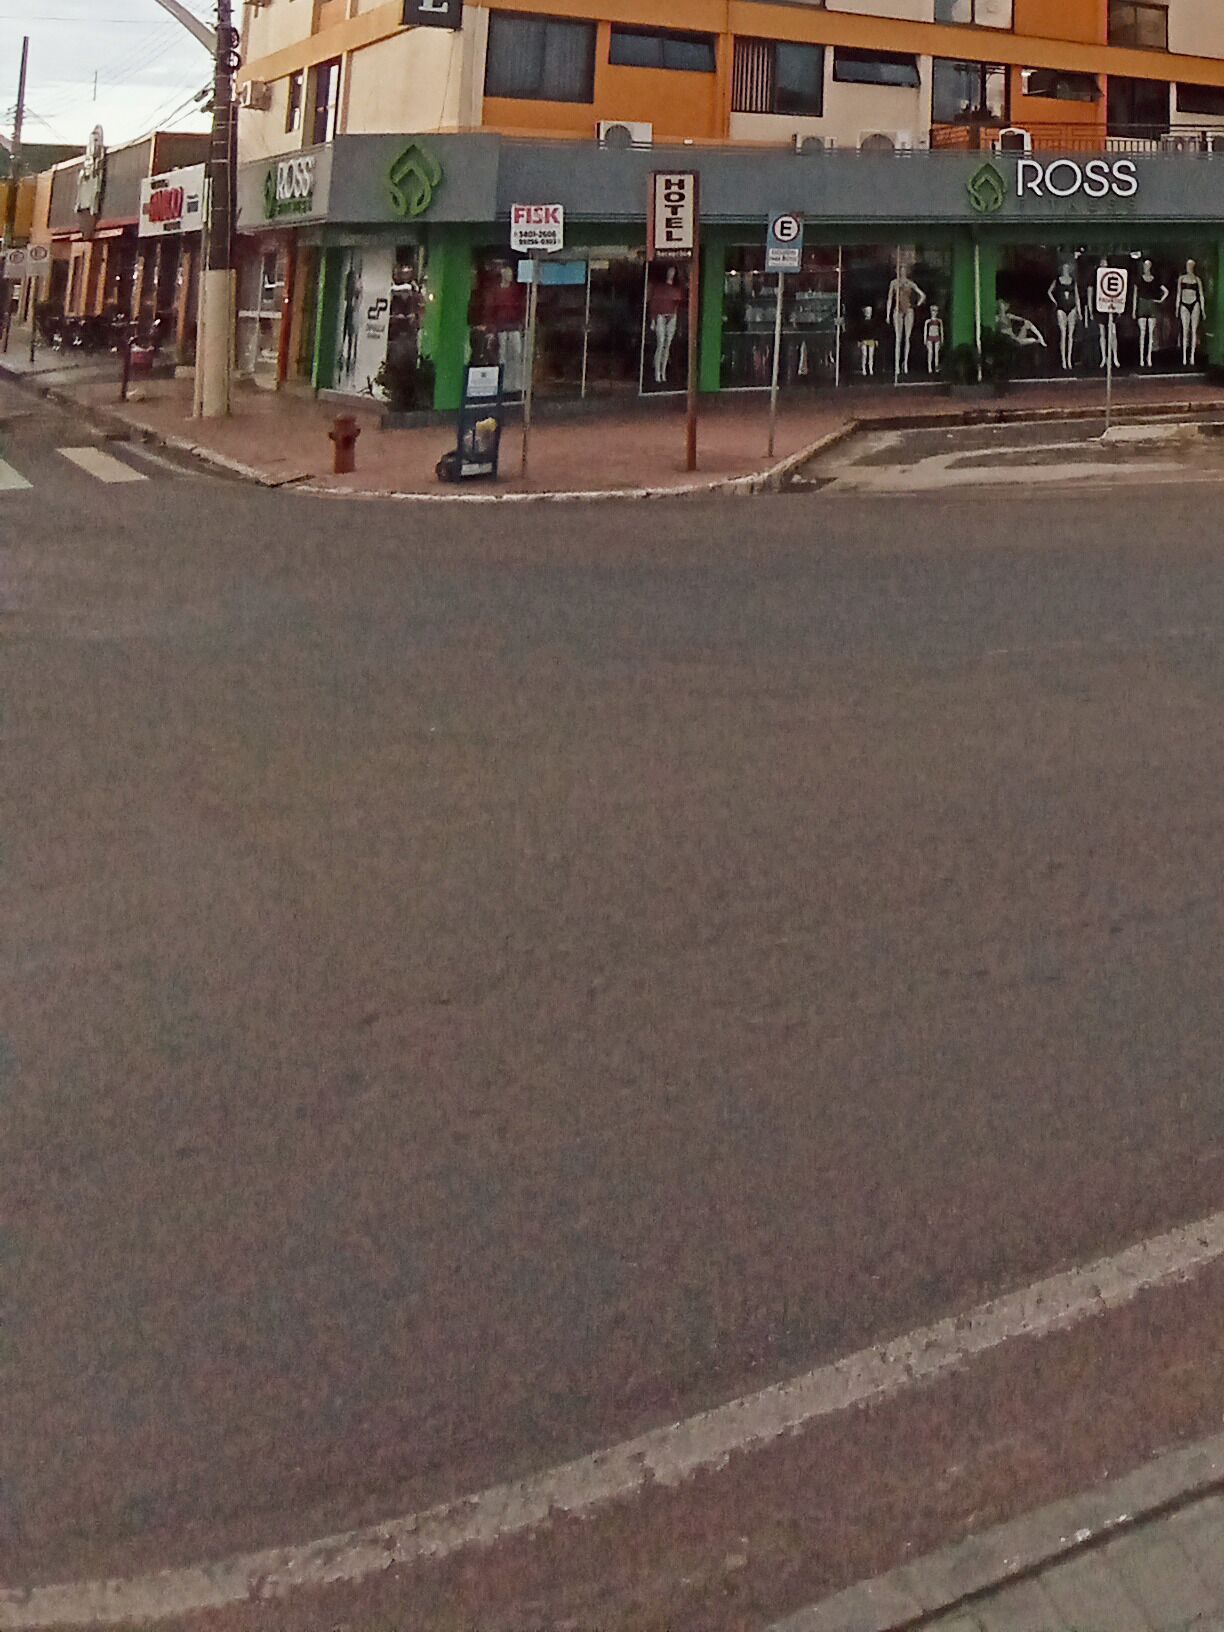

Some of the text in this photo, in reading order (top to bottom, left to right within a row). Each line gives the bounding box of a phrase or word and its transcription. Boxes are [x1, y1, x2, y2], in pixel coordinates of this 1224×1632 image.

[276, 156, 314, 200] ROSS
[1016, 159, 1139, 197] ROSS
[514, 207, 560, 224] FISK
[664, 178, 686, 241] HOTEL
[781, 220, 792, 236] E
[1107, 276, 1119, 292] E
